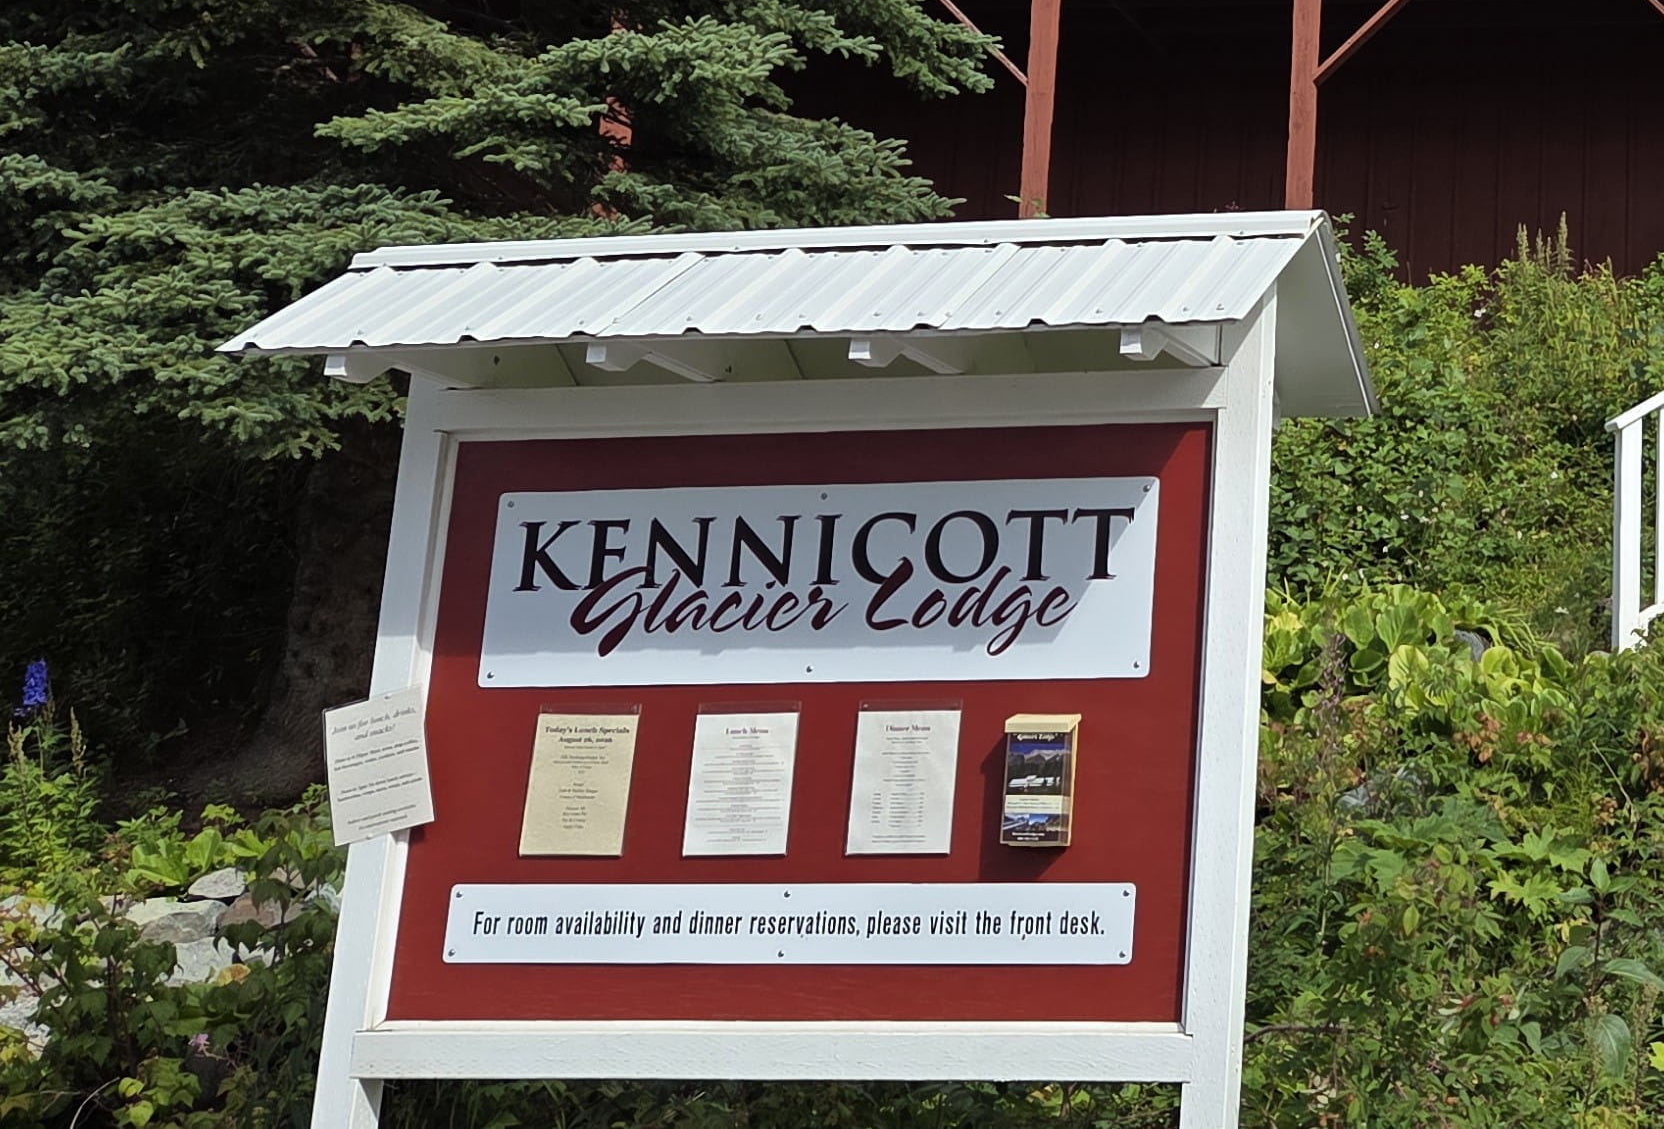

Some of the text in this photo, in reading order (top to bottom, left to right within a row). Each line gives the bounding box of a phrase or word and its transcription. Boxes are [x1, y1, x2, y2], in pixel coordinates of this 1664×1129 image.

[512, 508, 1136, 592] KENNICOTT
[569, 555, 1079, 658] Glacier Lodge
[545, 726, 630, 736] Today's Lunch Specials
[725, 726, 769, 735] Lunch Menu
[472, 910, 1105, 939] For room availability and dinner reservations, please visit the front desk.
